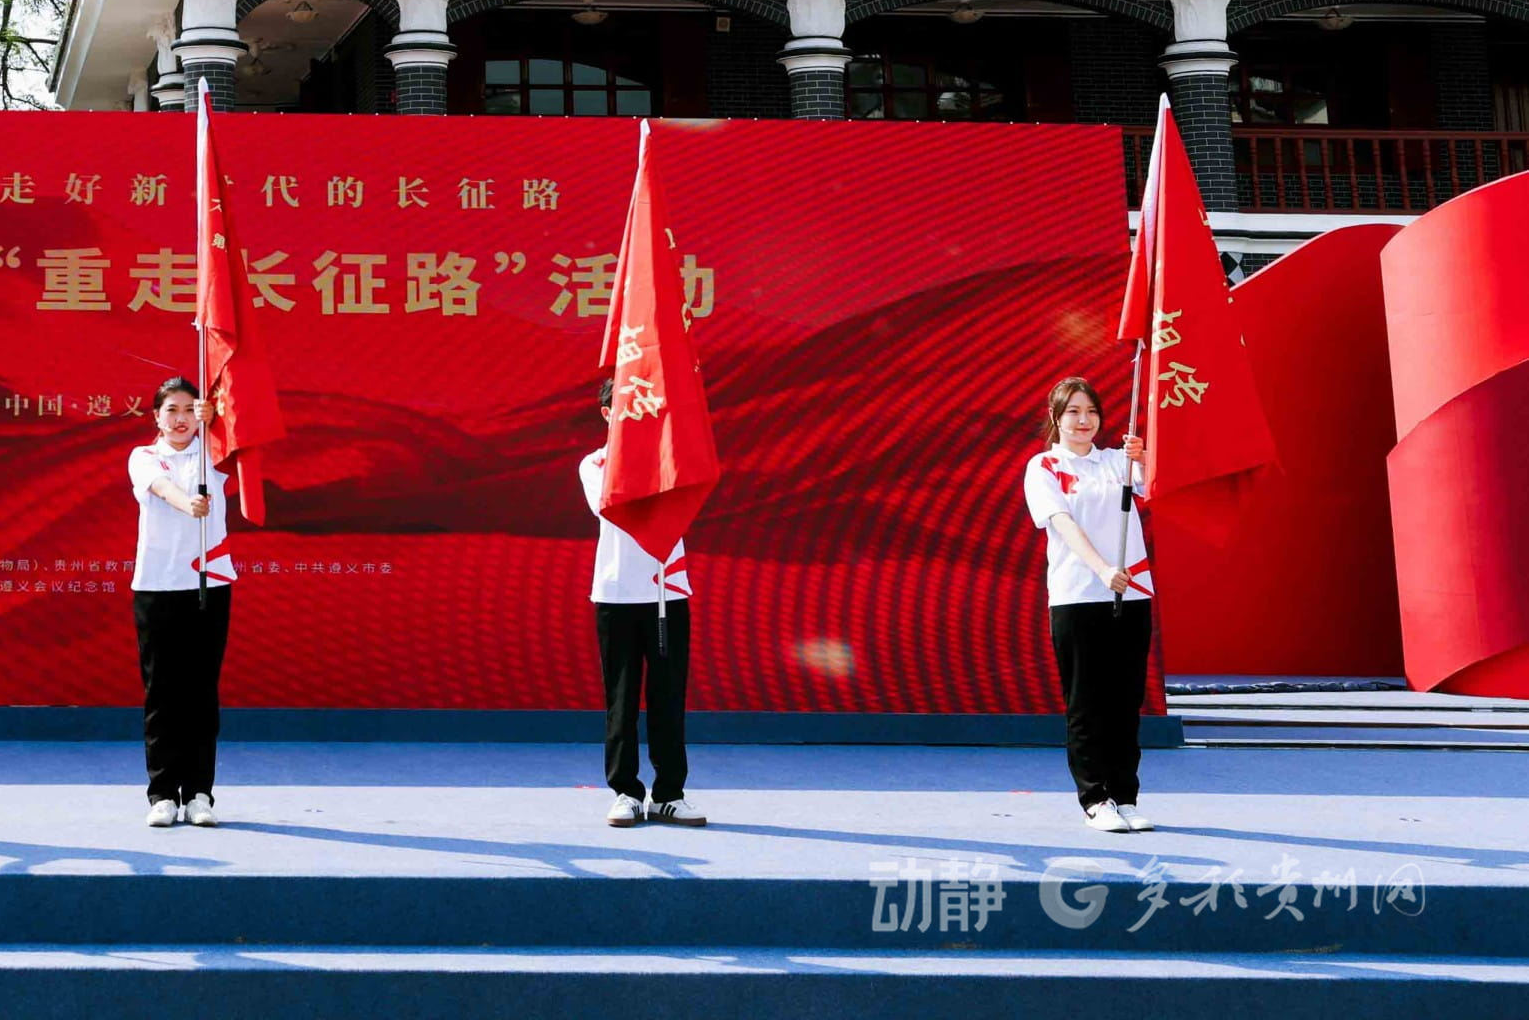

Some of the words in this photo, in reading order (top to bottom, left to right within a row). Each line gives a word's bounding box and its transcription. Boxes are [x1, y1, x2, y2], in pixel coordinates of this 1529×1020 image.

[0, 172, 561, 212] 走好新代的长征路
[5, 394, 145, 417] 中国·遵义
